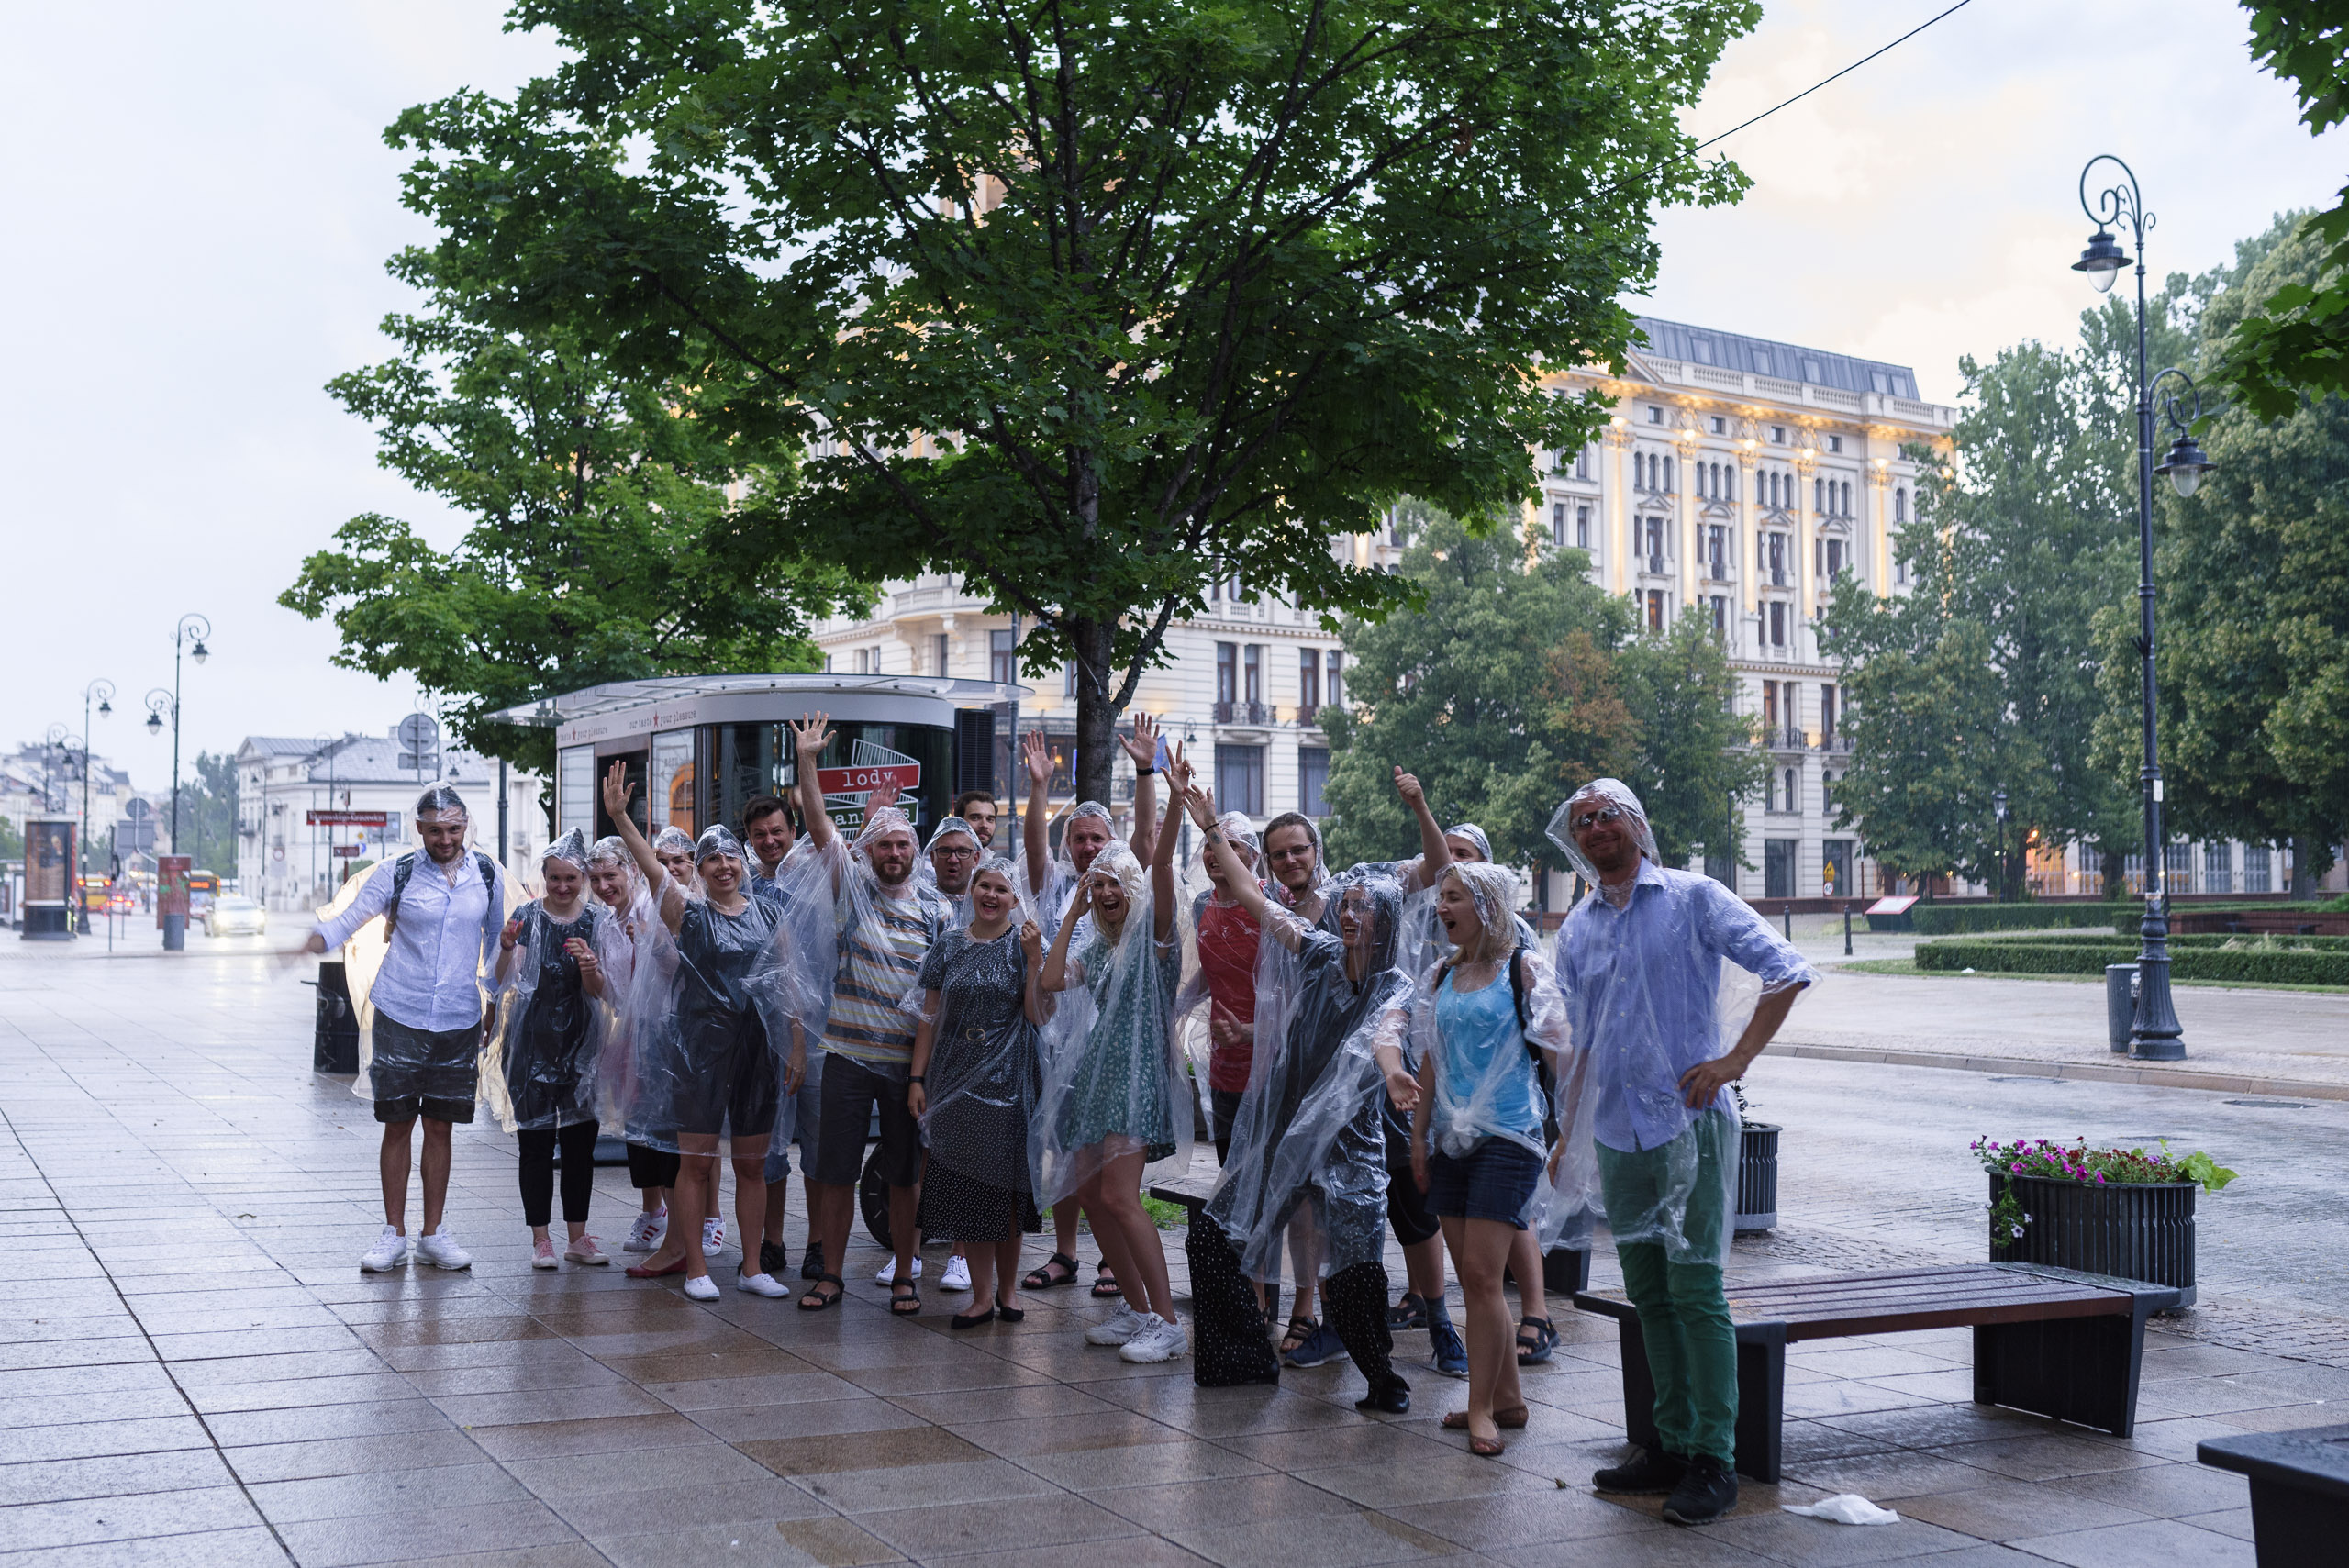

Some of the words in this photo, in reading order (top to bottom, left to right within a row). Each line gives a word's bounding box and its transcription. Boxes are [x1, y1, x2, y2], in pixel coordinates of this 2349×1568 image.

[639, 717, 652, 728] taste
[660, 714, 673, 727] your
[674, 710, 696, 725] pleasure
